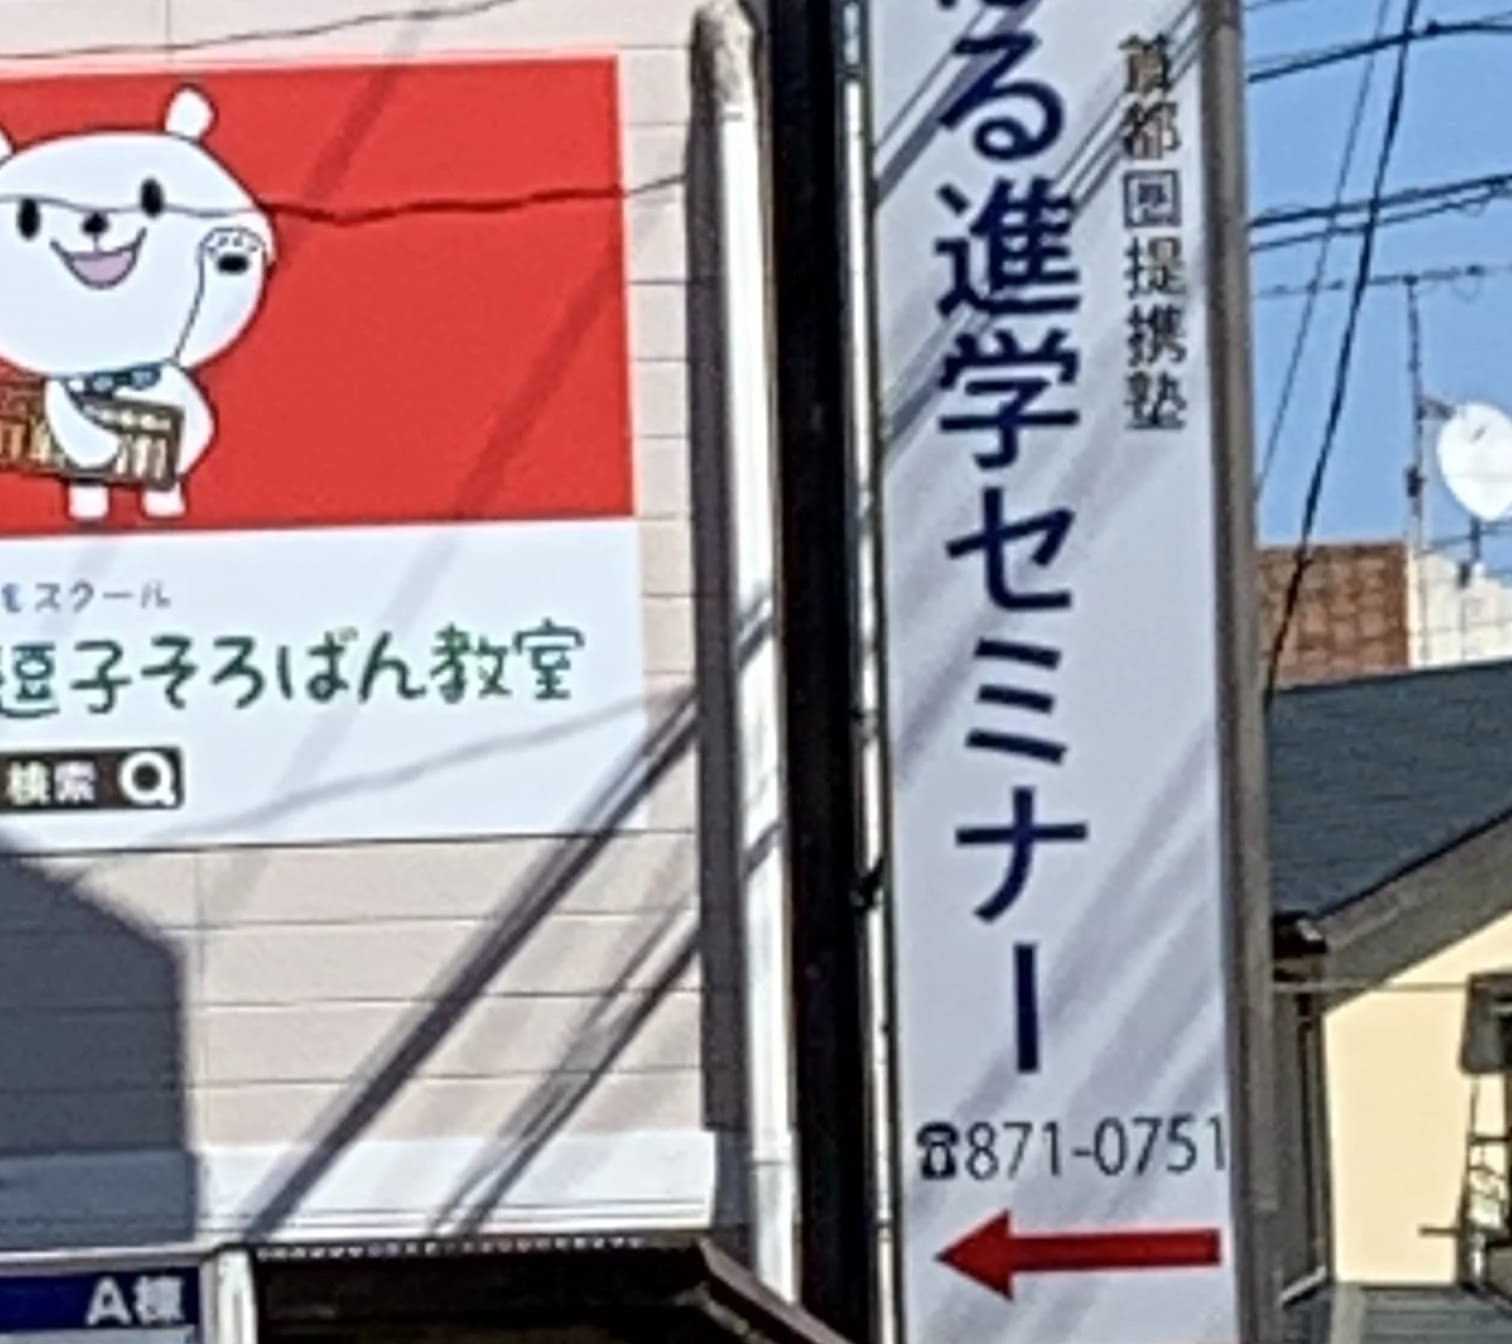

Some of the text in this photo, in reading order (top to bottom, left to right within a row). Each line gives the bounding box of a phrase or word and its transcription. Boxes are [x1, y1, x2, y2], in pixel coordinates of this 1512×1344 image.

[1119, 34, 1187, 431] 首都圏提携塾
[5, 760, 97, 806] 検索
[964, 1114, 1227, 1181] 871-0751
